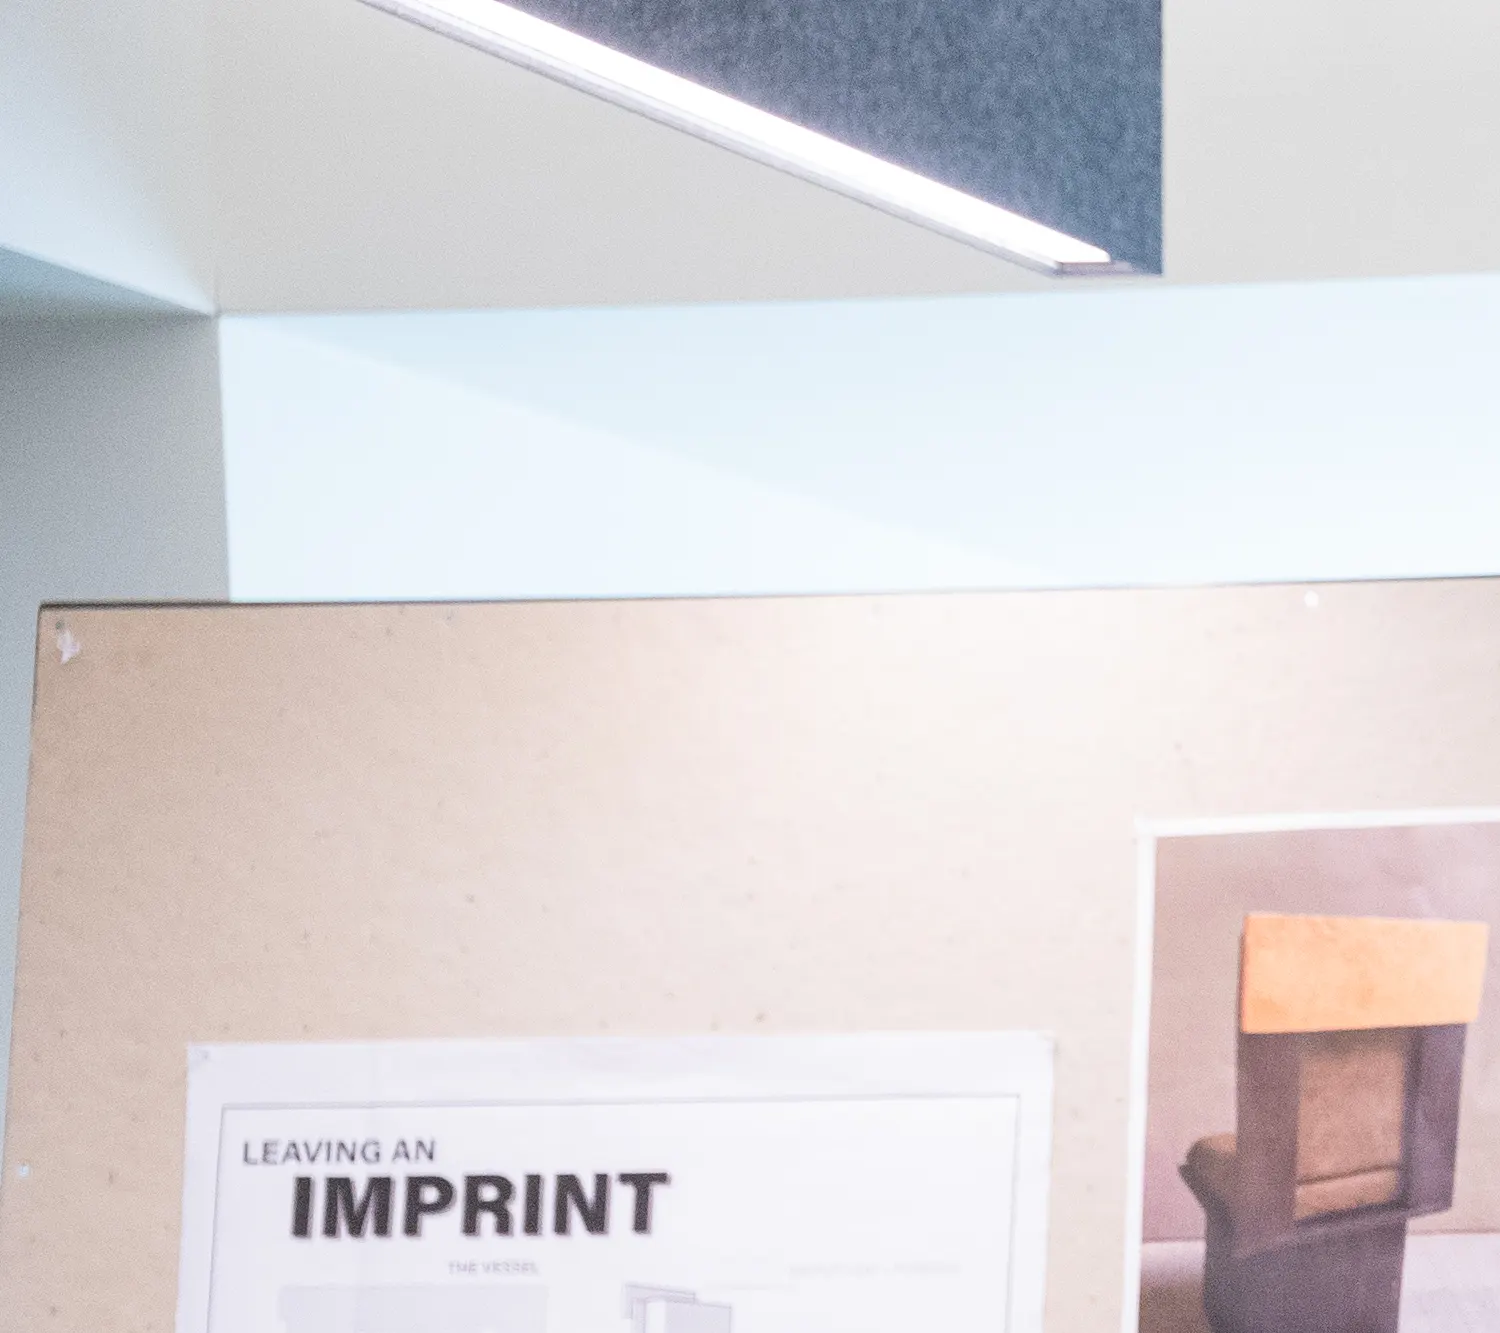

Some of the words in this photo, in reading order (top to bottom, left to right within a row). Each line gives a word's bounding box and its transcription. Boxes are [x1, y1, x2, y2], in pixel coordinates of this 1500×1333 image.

[243, 1140, 381, 1165] LEAVING
[392, 1139, 437, 1162] AN
[290, 1171, 673, 1238] IMPRINT
